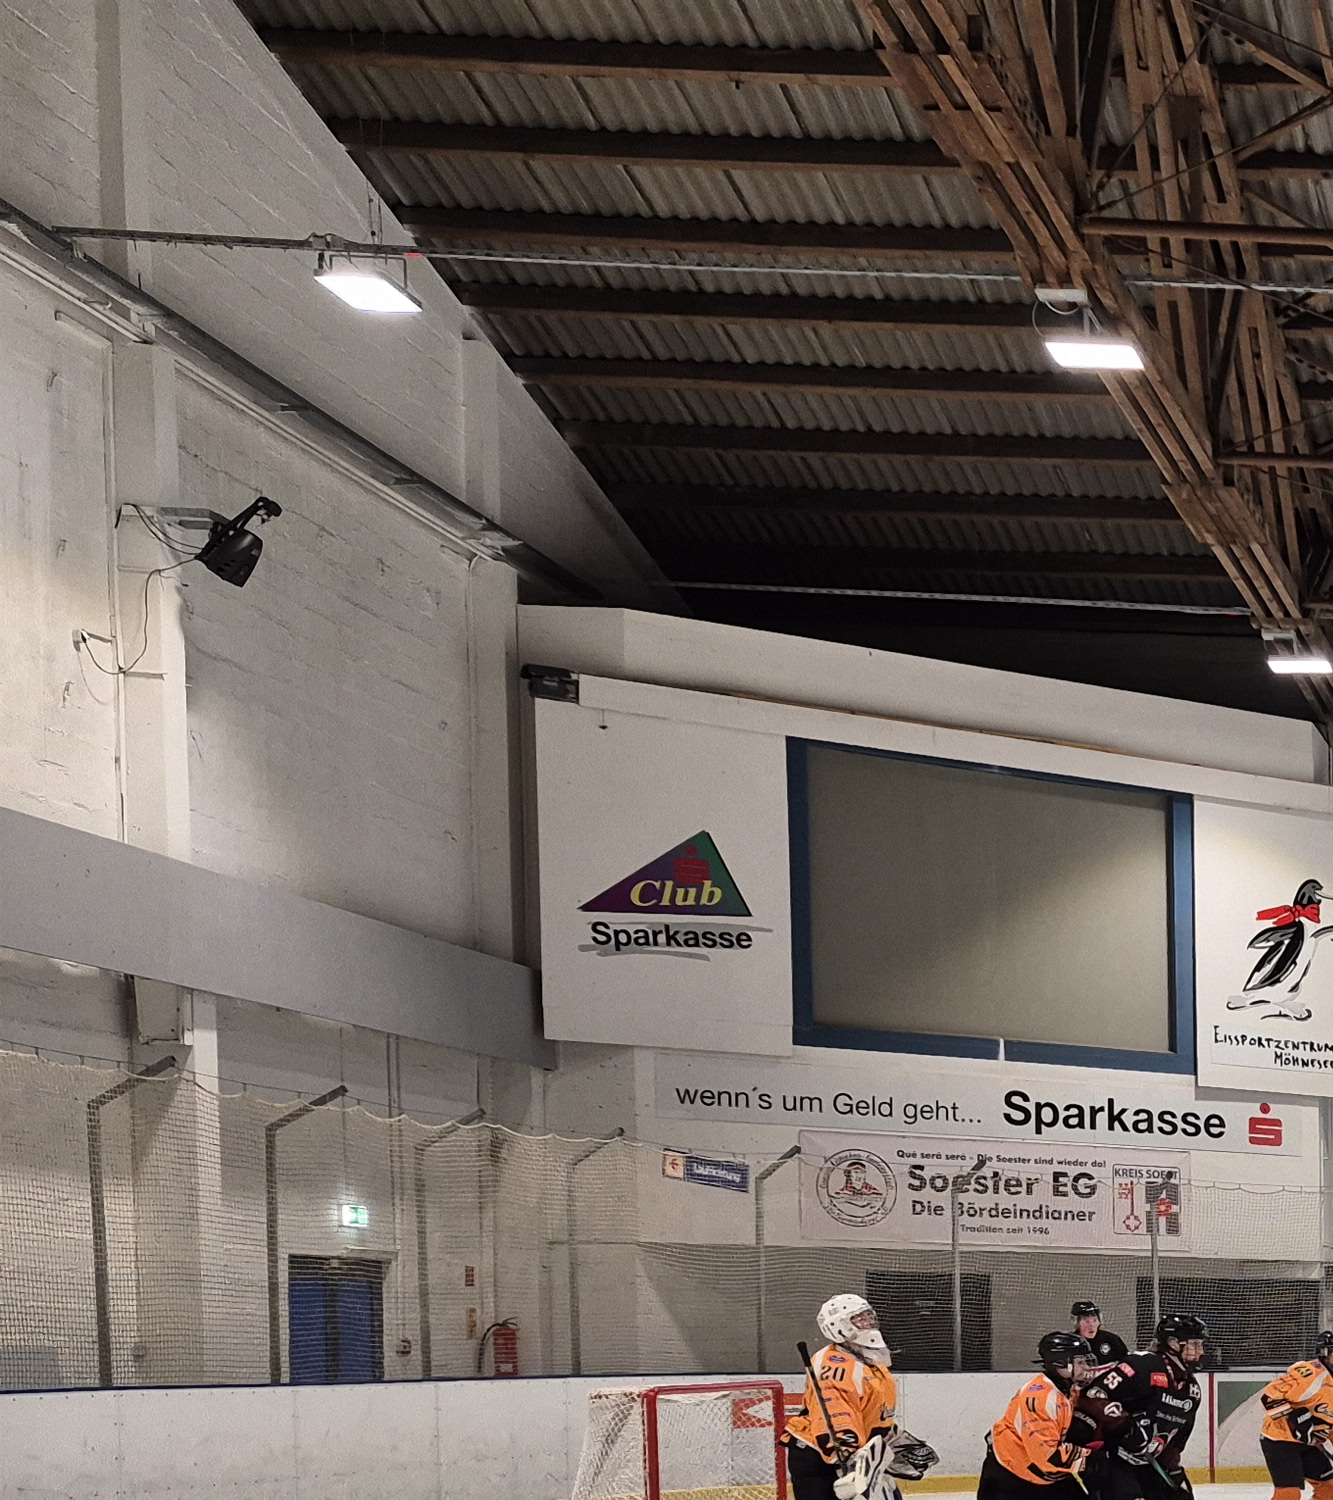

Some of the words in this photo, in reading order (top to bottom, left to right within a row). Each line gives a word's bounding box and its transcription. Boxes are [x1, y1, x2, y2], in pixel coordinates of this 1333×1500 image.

[630, 880, 722, 907] Club
[591, 921, 753, 951] Sparkasse
[782, 1094, 823, 1113] um
[833, 1092, 894, 1118] Geld
[903, 1100, 982, 1125] geht...
[1003, 1089, 1227, 1139] Sparkasse
[996, 1154, 1031, 1165] Soester
[1034, 1156, 1054, 1166] sind
[1057, 1156, 1089, 1168] wieder
[1114, 1168, 1144, 1180] KREIS
[1052, 1171, 1099, 1200] EG
[912, 1200, 946, 1217] Die
[820, 1365, 846, 1383] 20
[1103, 1371, 1123, 1390] 55
